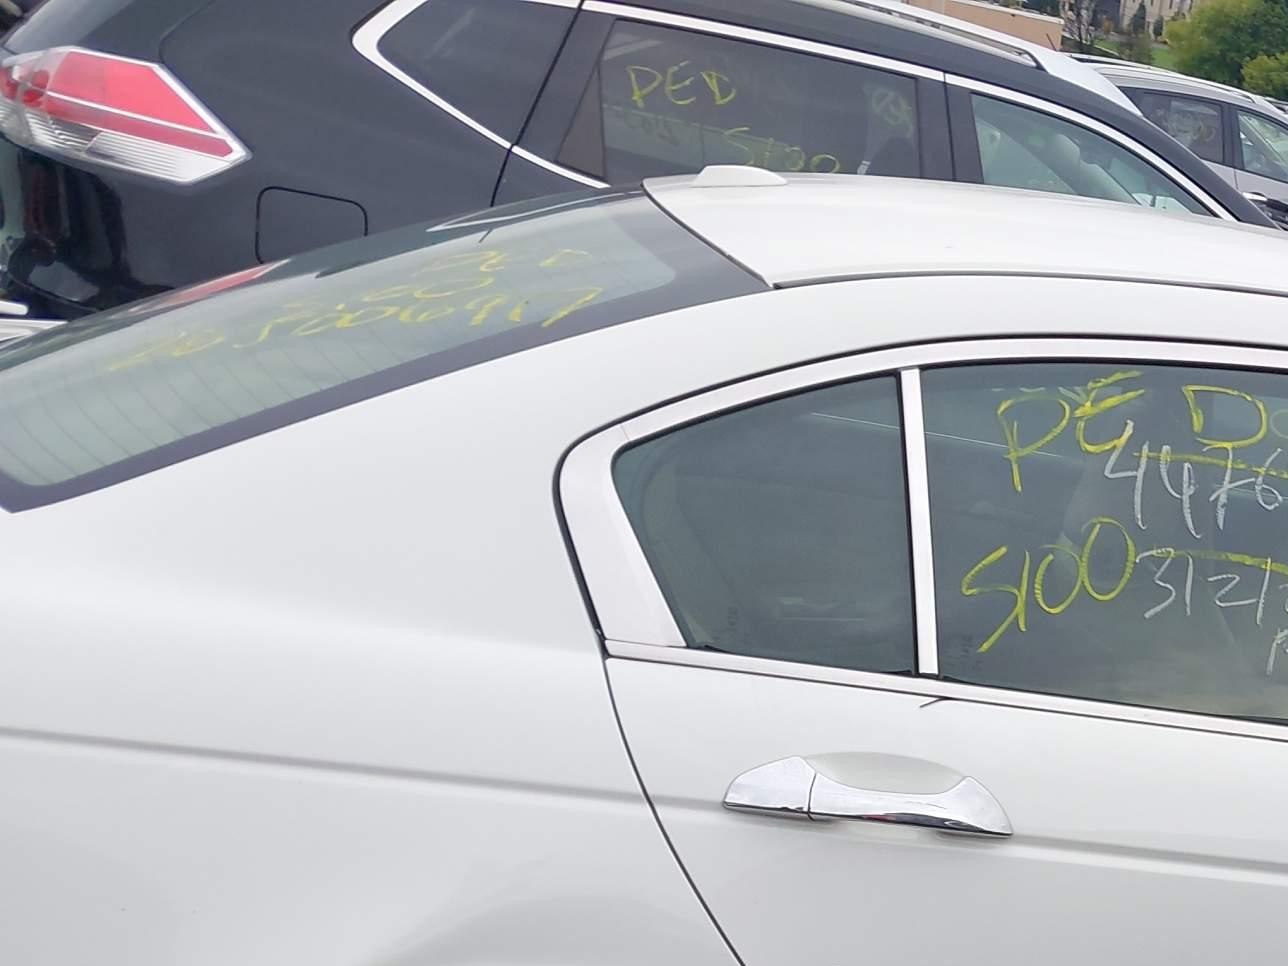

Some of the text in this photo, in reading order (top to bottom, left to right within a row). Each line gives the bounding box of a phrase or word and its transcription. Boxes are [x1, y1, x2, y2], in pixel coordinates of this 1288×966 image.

[626, 60, 738, 108] PED
[996, 370, 1268, 493] PED
[960, 515, 1136, 655] S100
